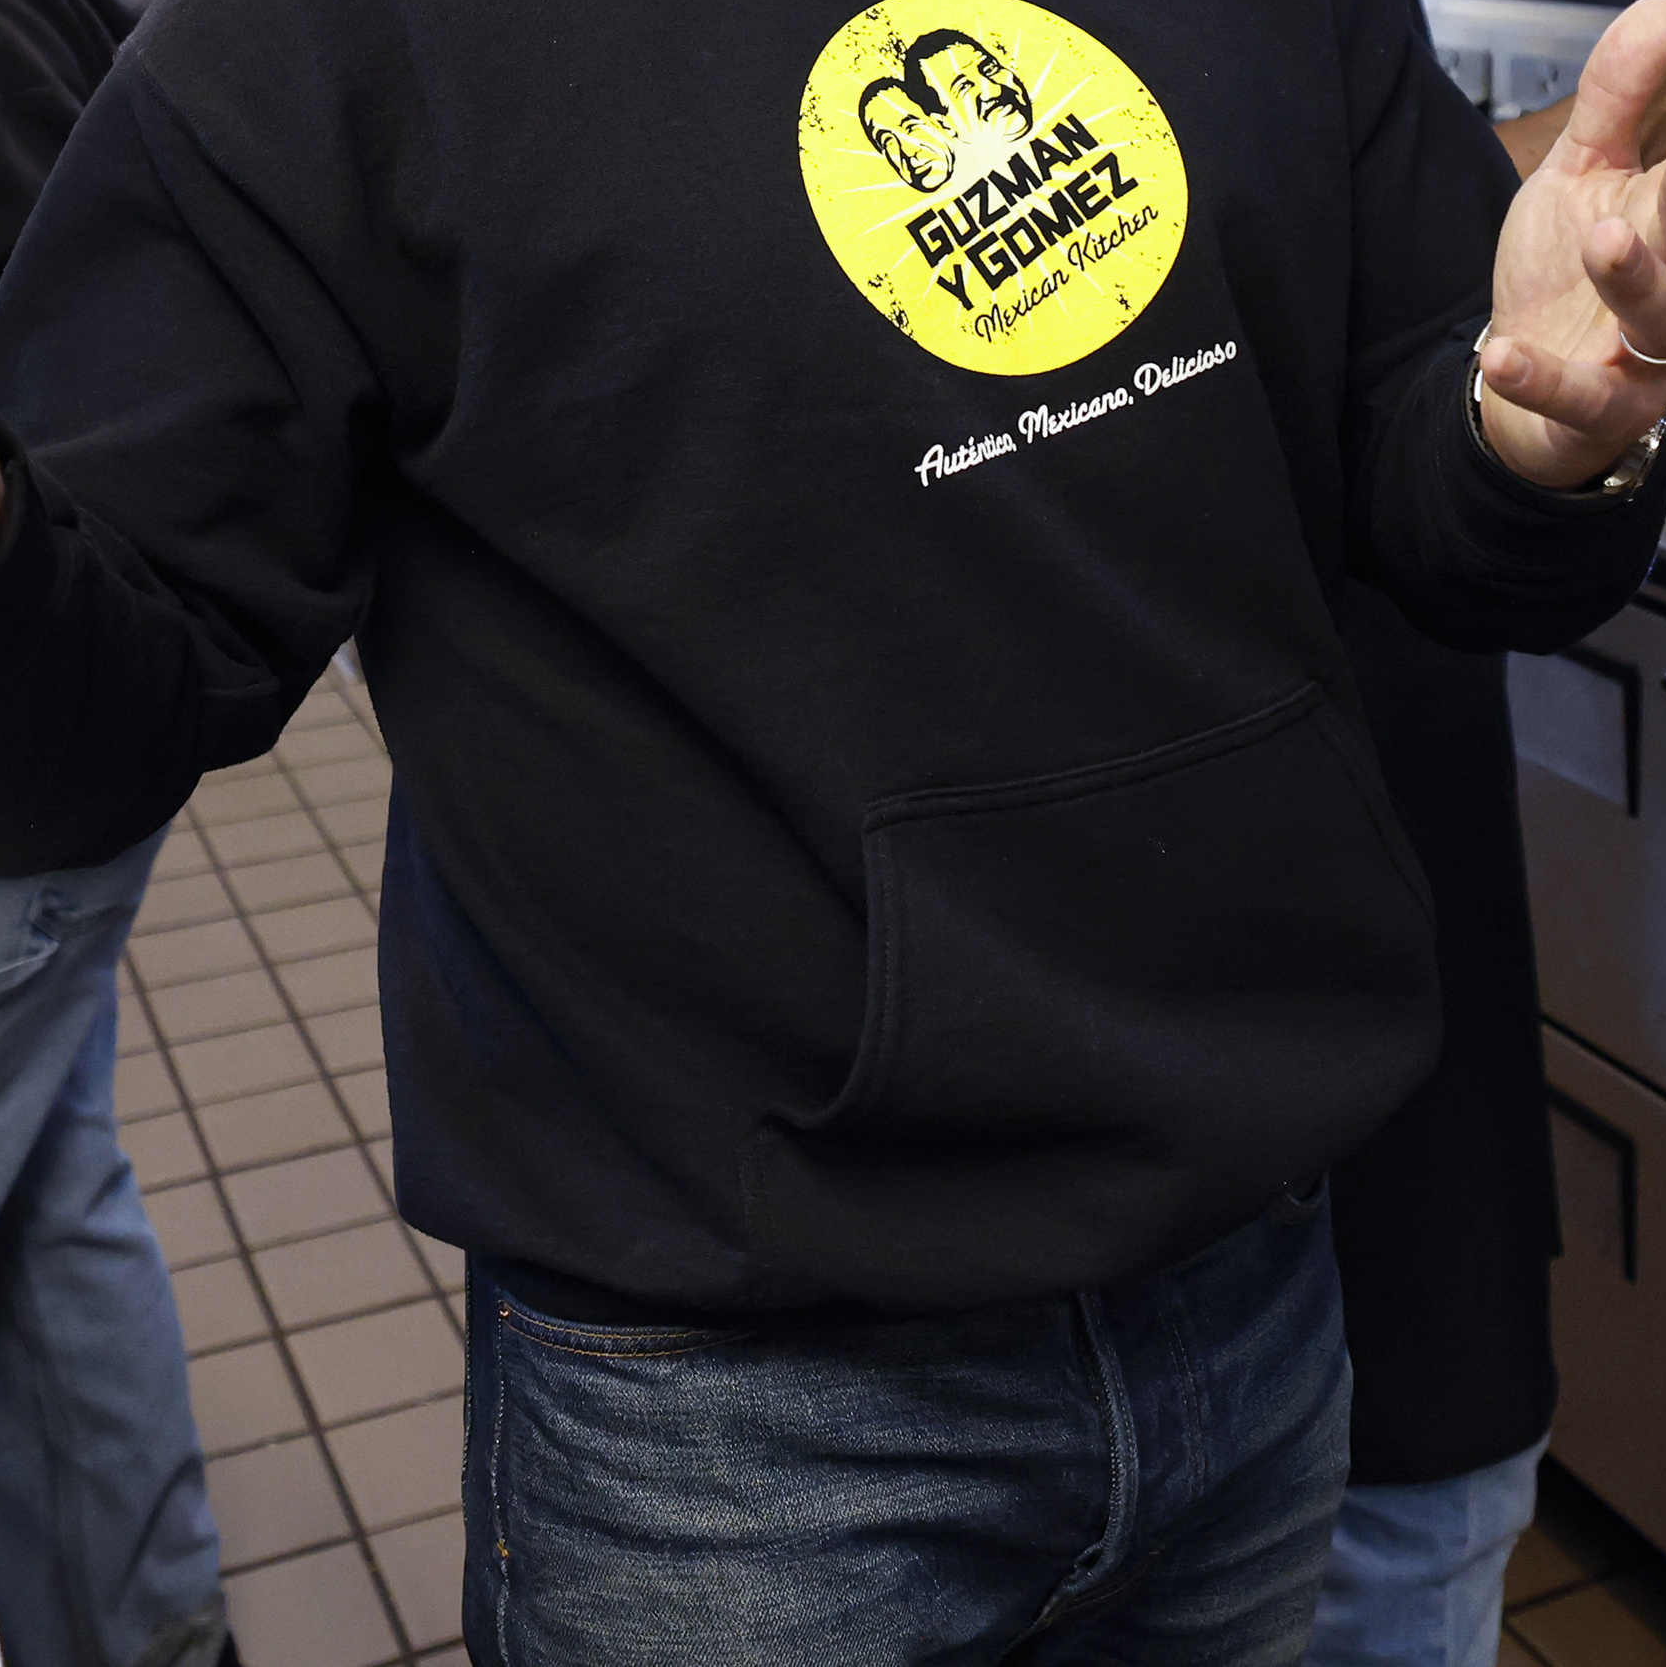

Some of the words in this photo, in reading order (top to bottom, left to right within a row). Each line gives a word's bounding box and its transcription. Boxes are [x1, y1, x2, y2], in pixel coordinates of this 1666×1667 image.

[905, 114, 1099, 270] GUZMAN
[936, 263, 974, 310] Y
[966, 152, 1138, 291] GOMEZ
[974, 270, 1070, 343] Mexican
[1068, 205, 1159, 278] Kitchen
[1018, 389, 1134, 444] Mexicano,
[1134, 339, 1237, 397] Delicioso
